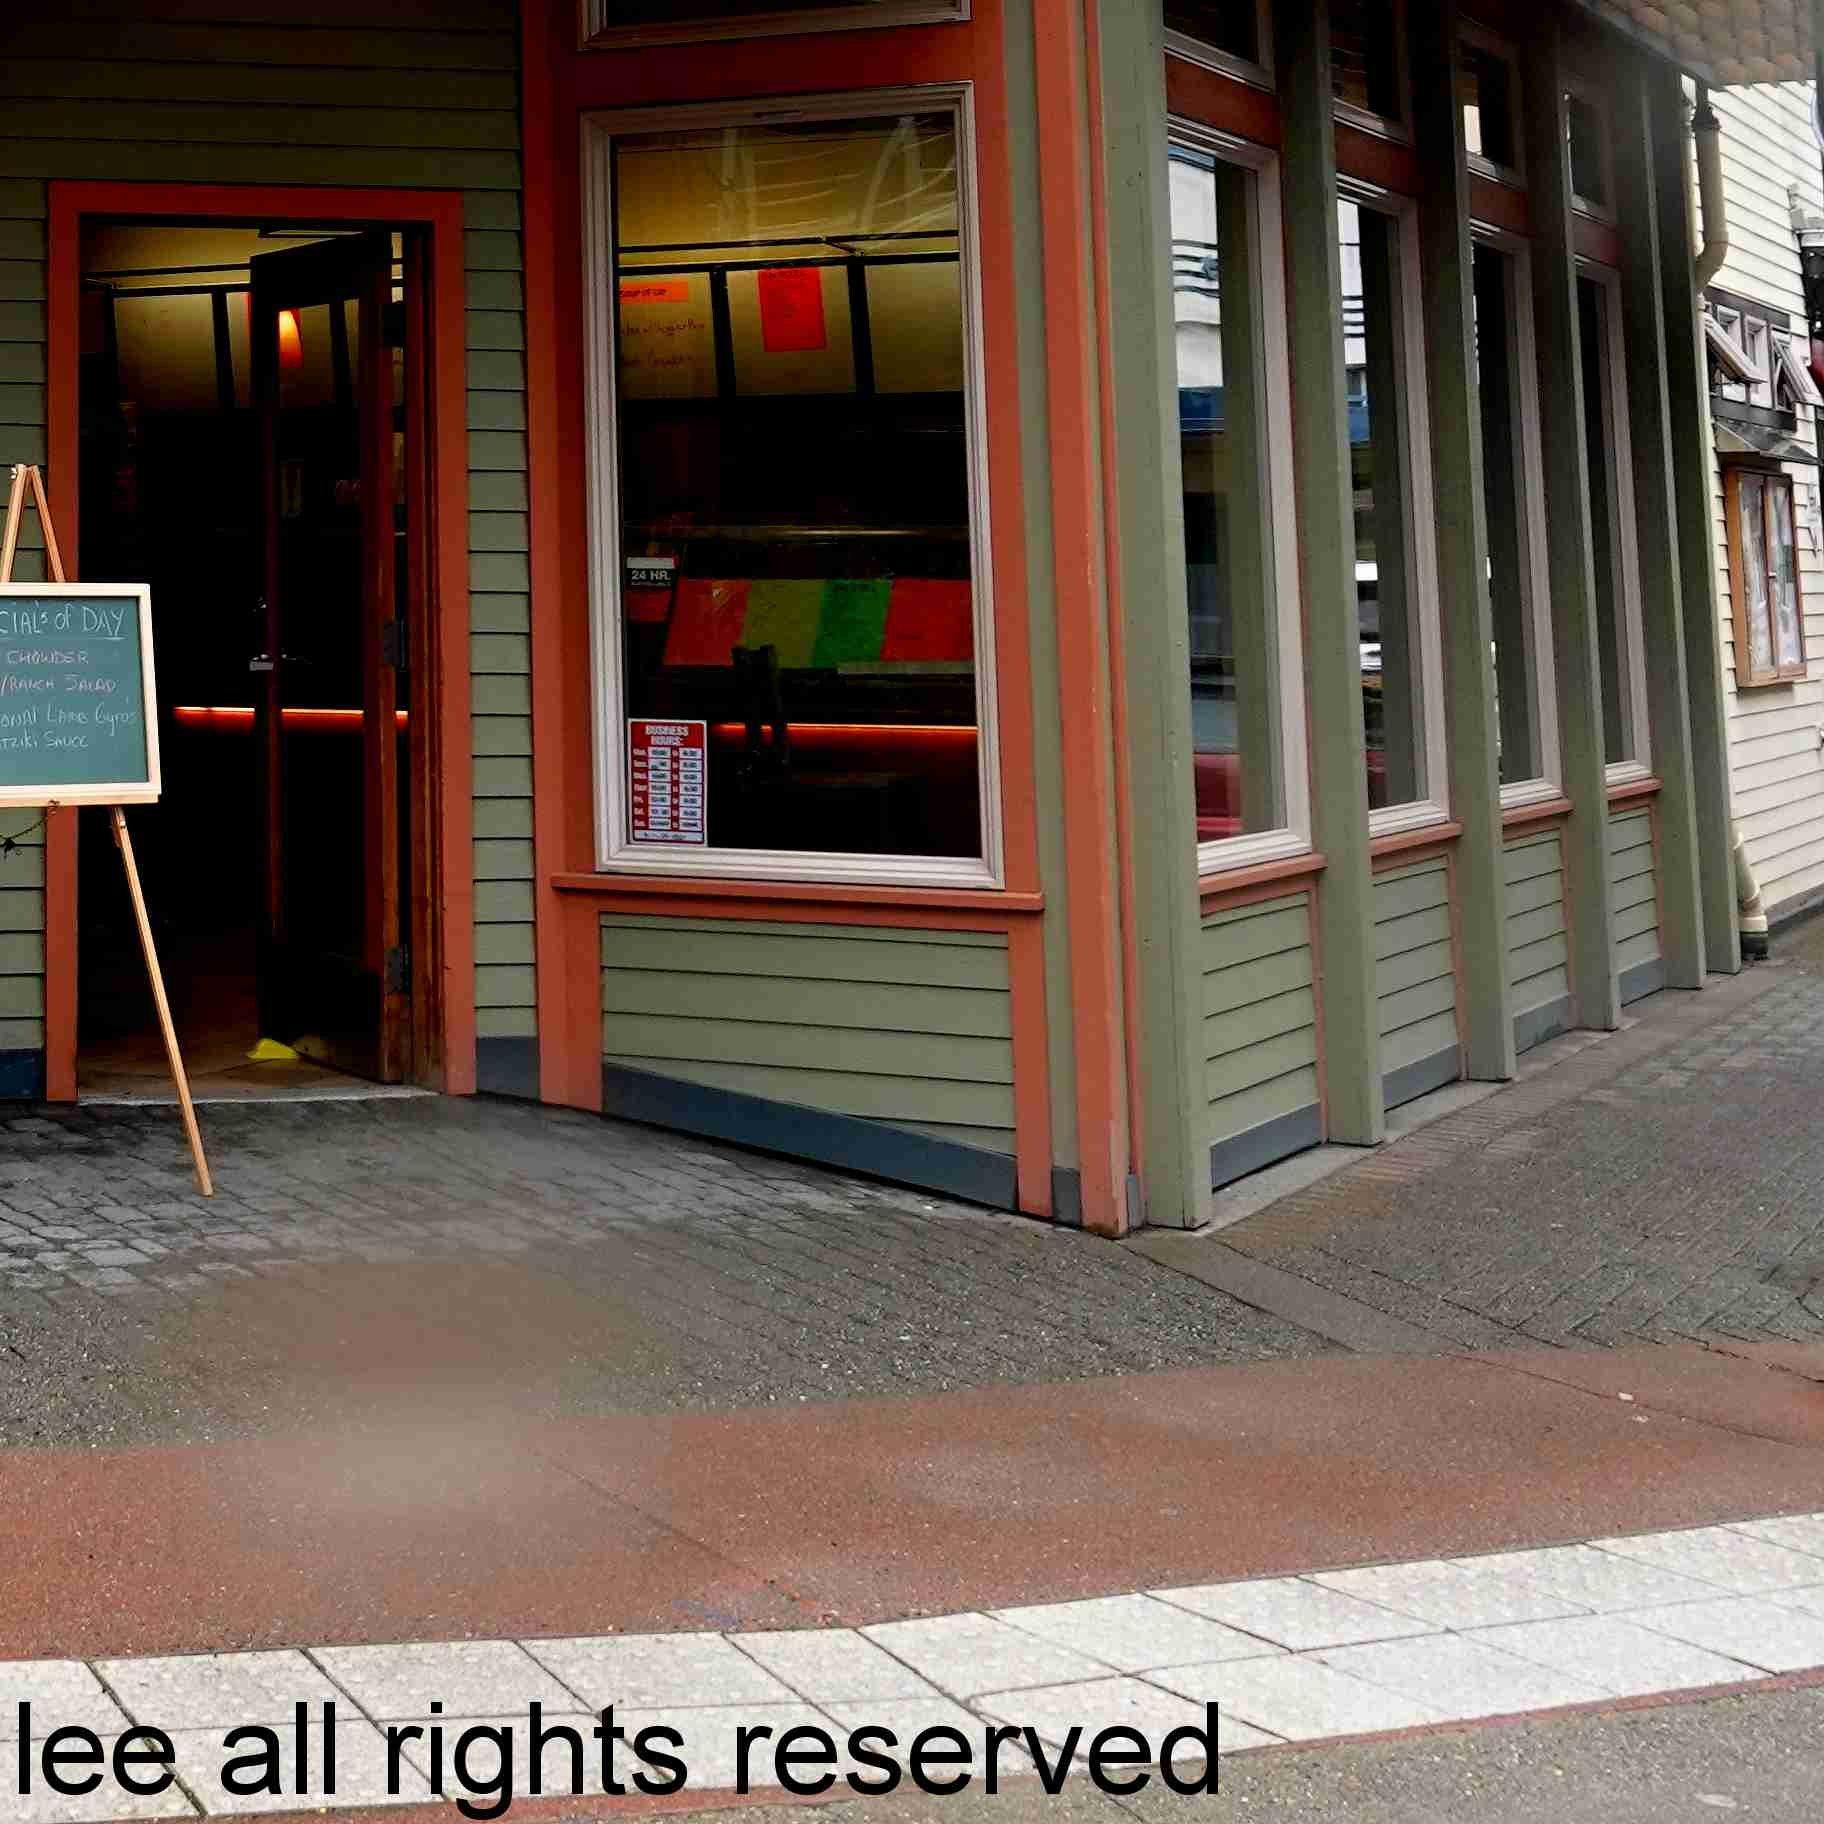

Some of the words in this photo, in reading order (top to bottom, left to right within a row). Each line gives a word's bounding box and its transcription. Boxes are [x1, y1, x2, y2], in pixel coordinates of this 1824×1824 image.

[631, 569, 647, 581] 24
[55, 602, 73, 631] of
[82, 606, 126, 638] DAY
[7, 649, 89, 665] CHOWDER
[65, 673, 118, 693] SALAD
